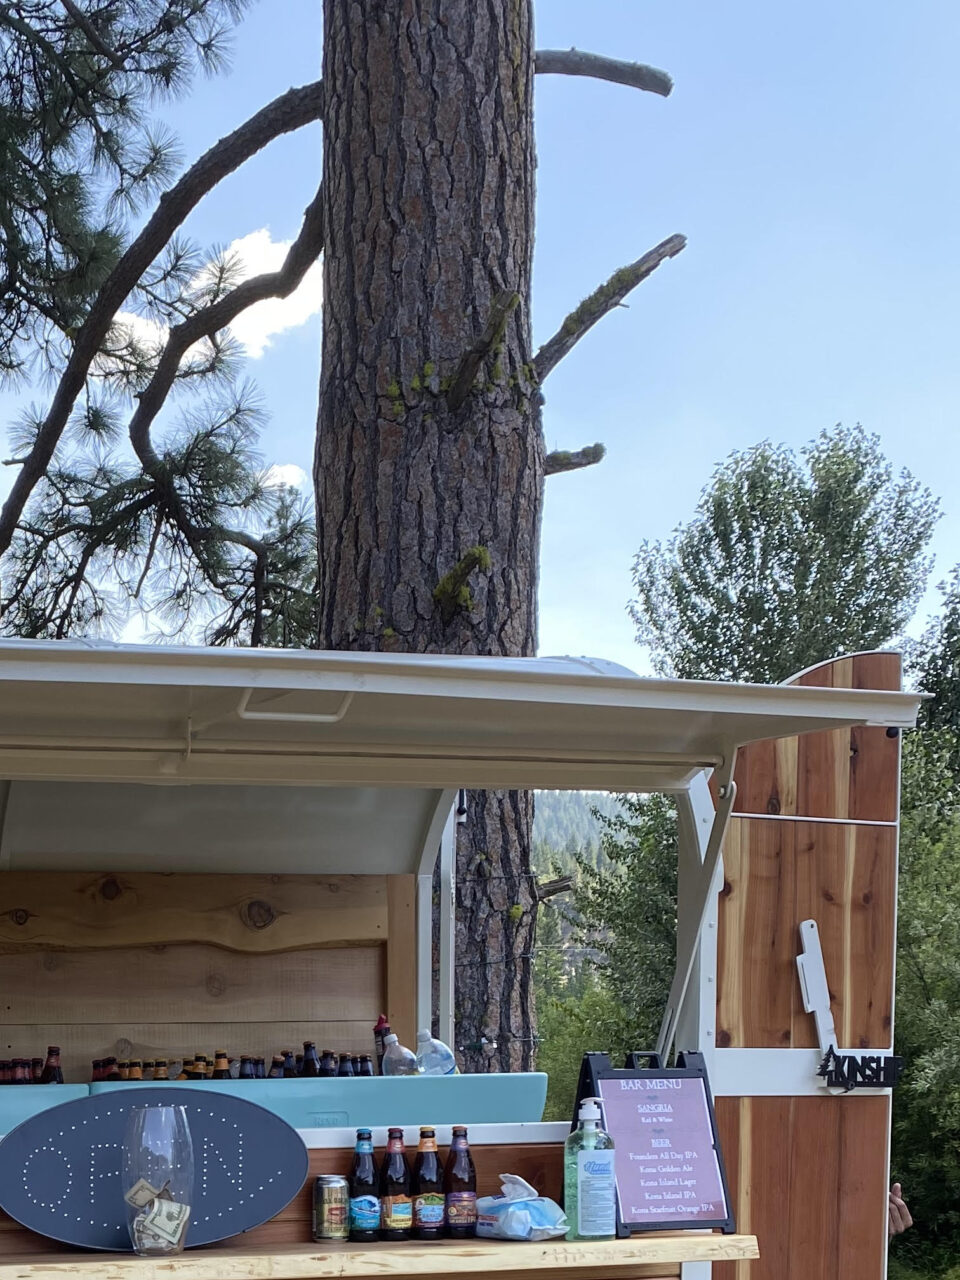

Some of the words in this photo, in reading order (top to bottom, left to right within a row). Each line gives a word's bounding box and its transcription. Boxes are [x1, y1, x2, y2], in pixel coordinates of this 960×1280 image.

[621, 1080, 643, 1090] BAR
[646, 1080, 682, 1090] MENU
[638, 1104, 673, 1113] SANGRIA
[651, 1139, 672, 1148] BEER
